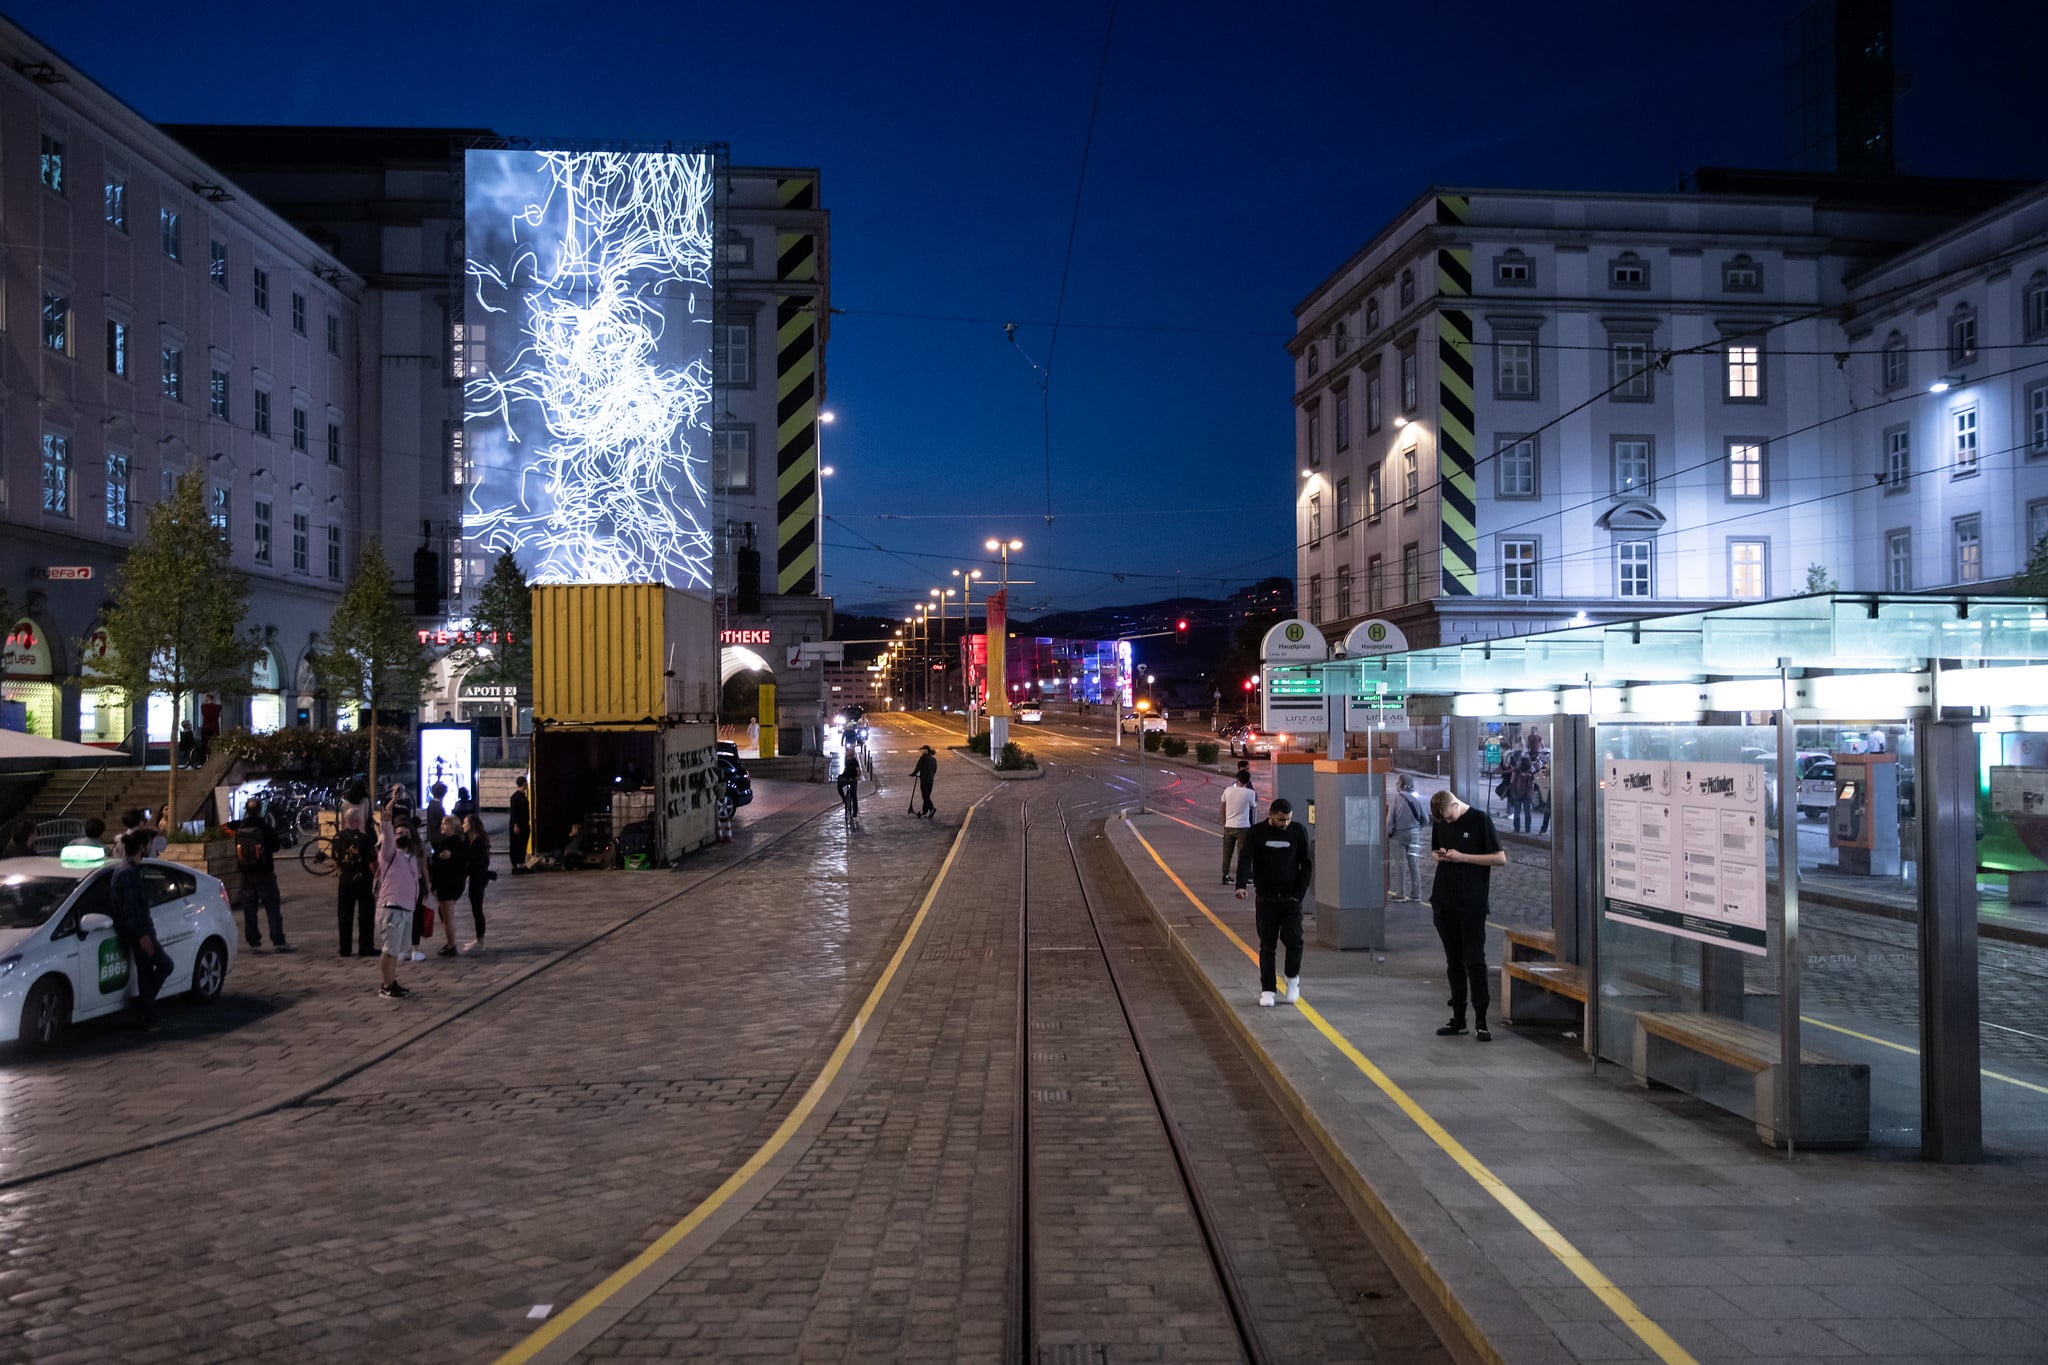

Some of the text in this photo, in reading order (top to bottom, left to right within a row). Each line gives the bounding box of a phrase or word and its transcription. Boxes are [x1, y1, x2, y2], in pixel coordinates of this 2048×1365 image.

[720, 630, 770, 644] THEKE
[104, 952, 122, 963] TAX
[101, 960, 128, 979] 6969
